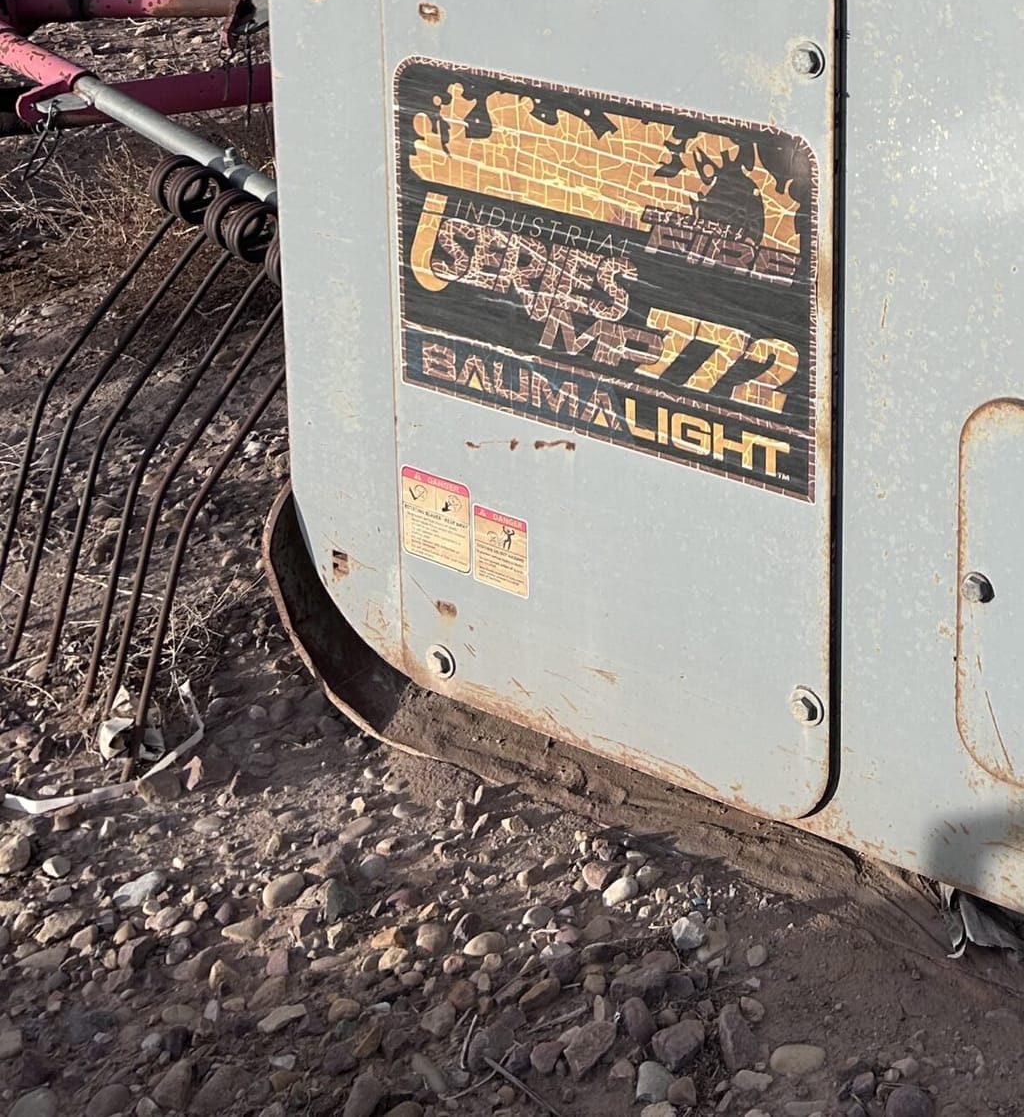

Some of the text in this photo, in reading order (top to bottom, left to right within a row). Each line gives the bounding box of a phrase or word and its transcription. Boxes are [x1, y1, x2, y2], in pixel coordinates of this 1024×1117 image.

[455, 199, 632, 260] INDUSTRIAL
[421, 340, 790, 478] BAUMALIGHT
[493, 514, 524, 529] DANGER
